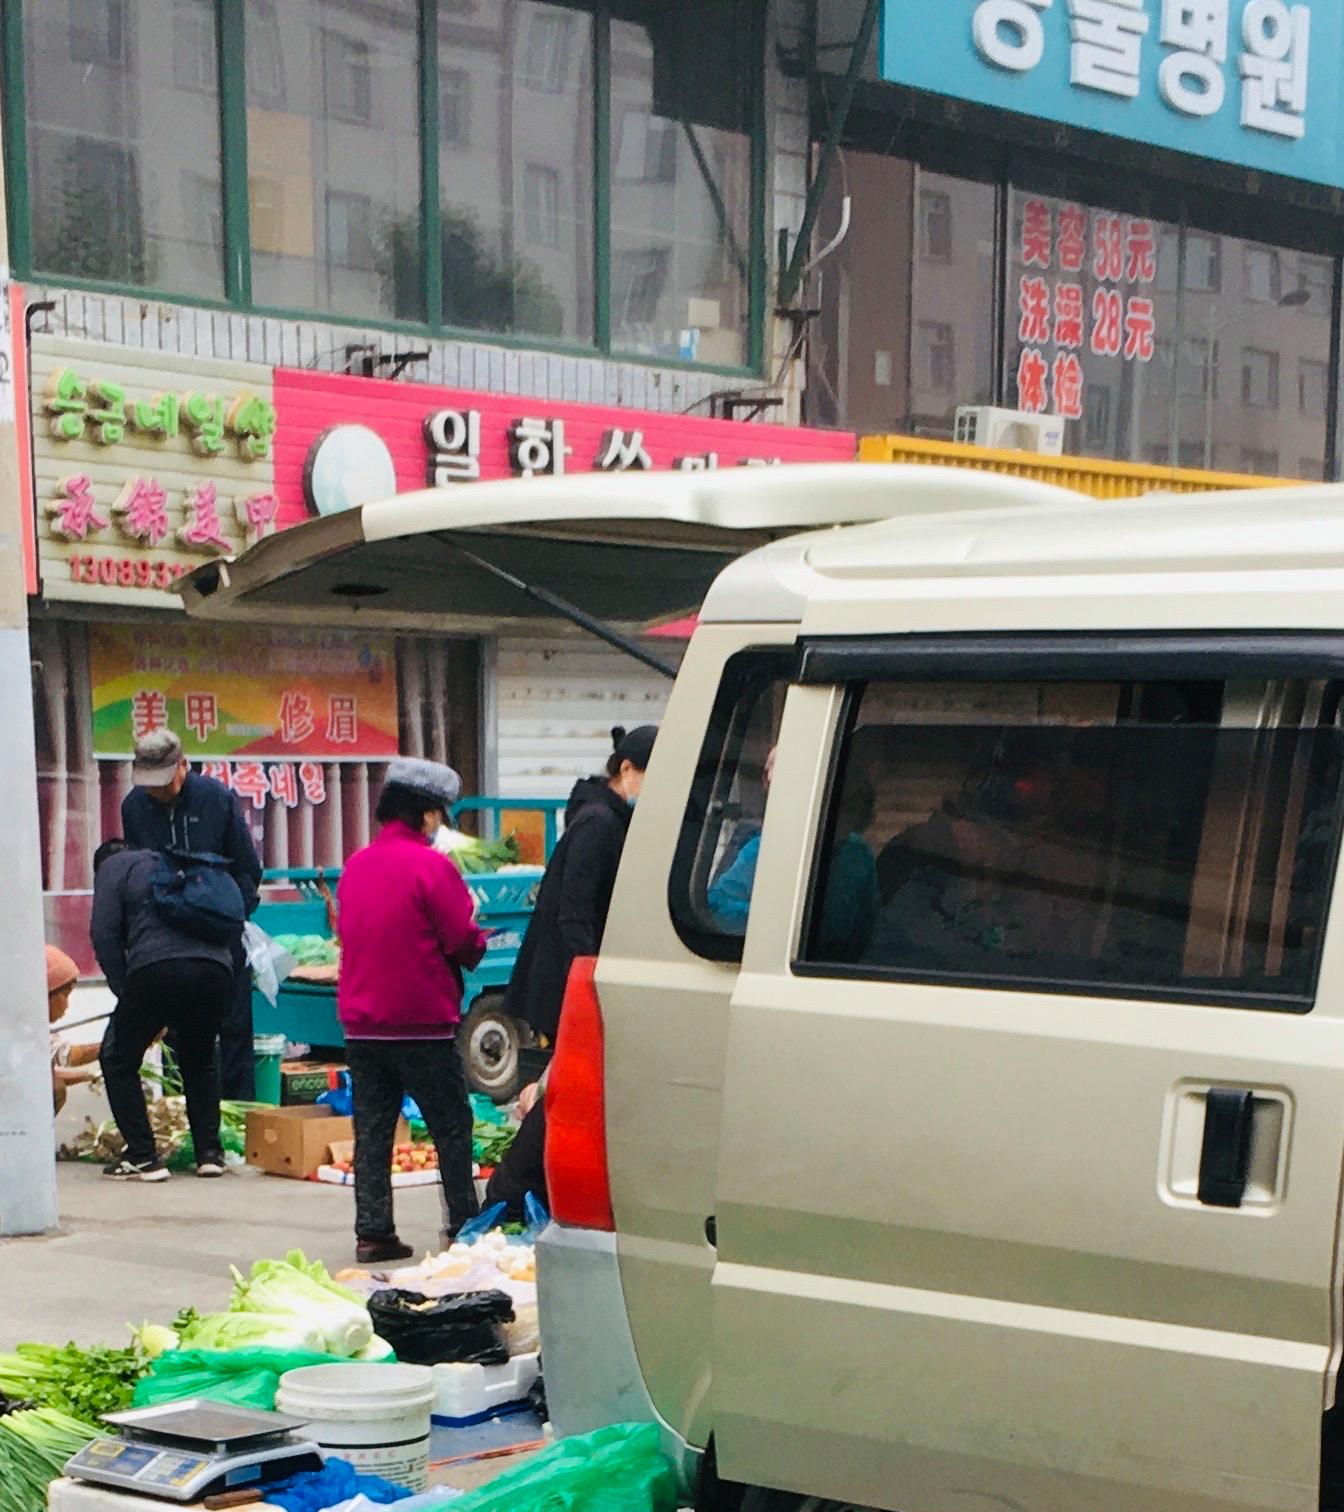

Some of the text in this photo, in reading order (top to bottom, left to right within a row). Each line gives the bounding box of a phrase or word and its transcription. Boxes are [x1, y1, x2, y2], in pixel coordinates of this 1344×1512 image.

[1017, 348, 1084, 419] 体检
[68, 554, 197, 589] 130893
[280, 690, 357, 744] 修眉
